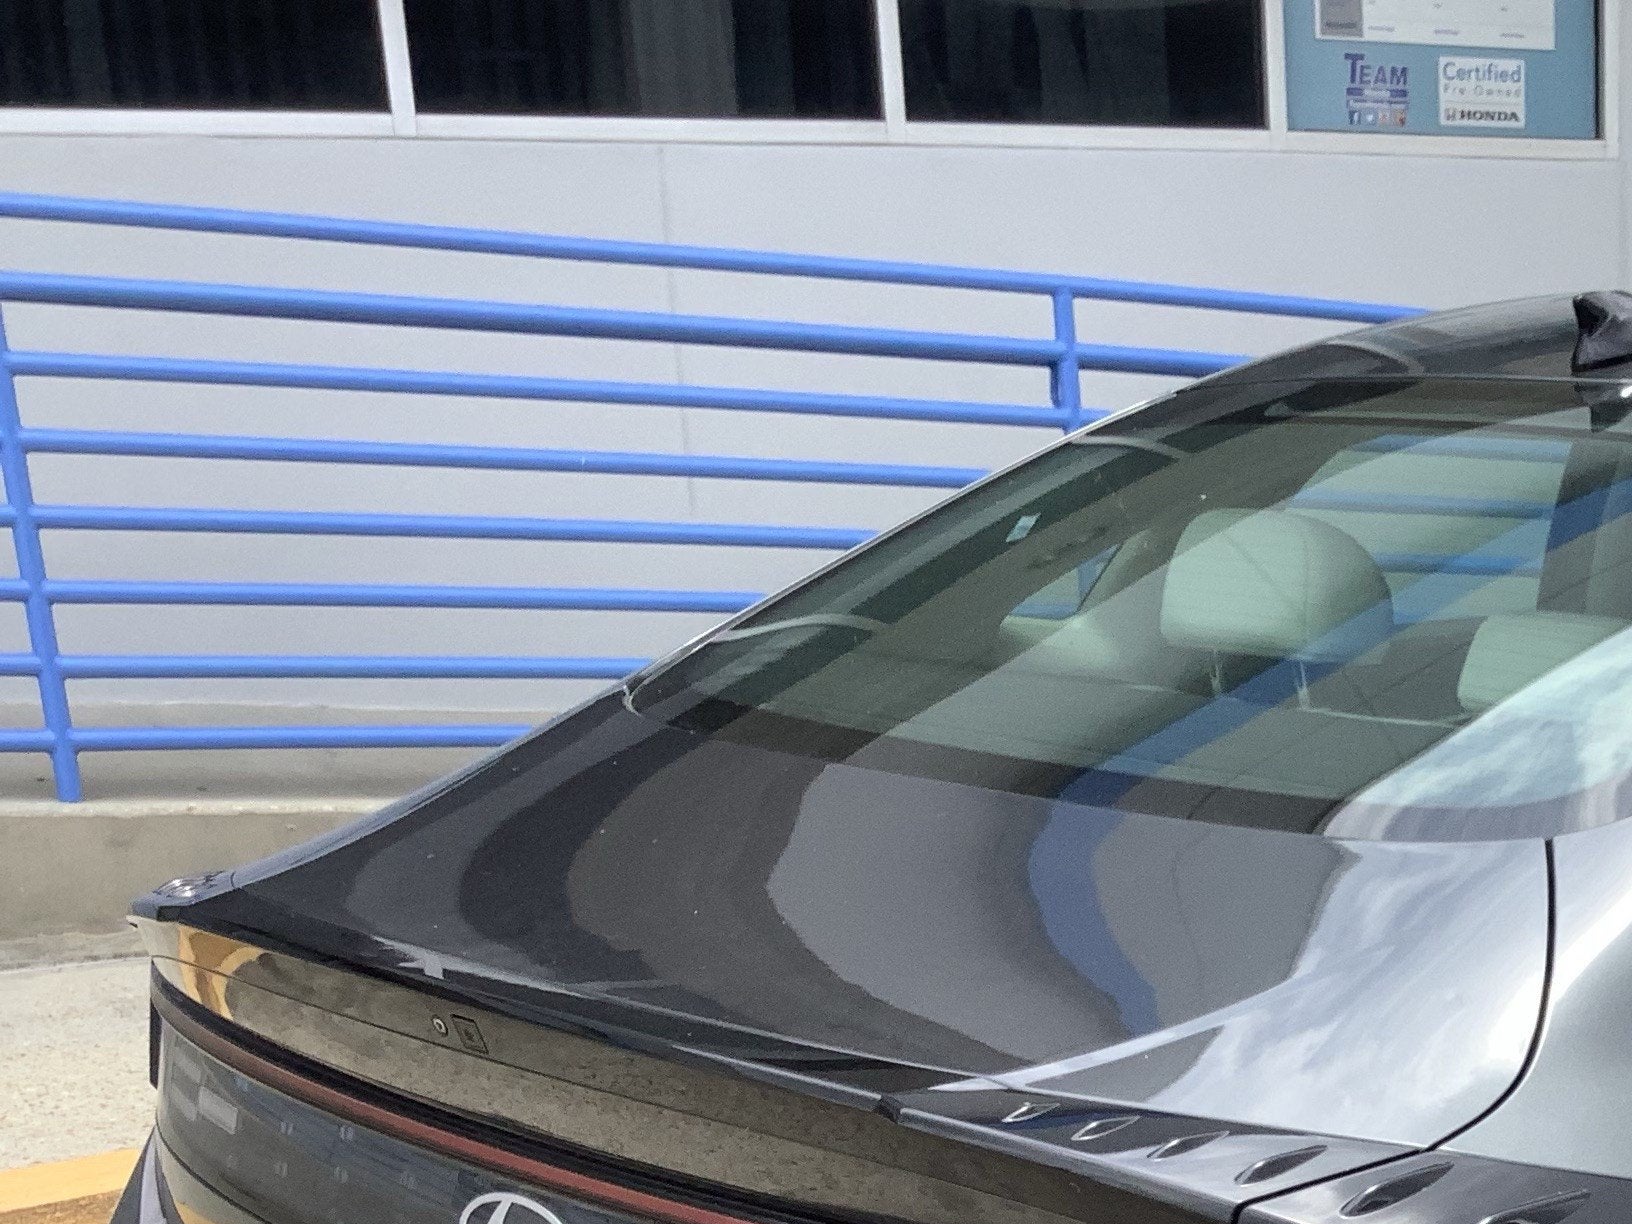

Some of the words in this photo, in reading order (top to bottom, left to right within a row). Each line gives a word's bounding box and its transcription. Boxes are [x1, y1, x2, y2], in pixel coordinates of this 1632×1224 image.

[1344, 53, 1409, 85] TEAM
[1442, 61, 1522, 83] Certified
[1459, 109, 1520, 122] HONDA
